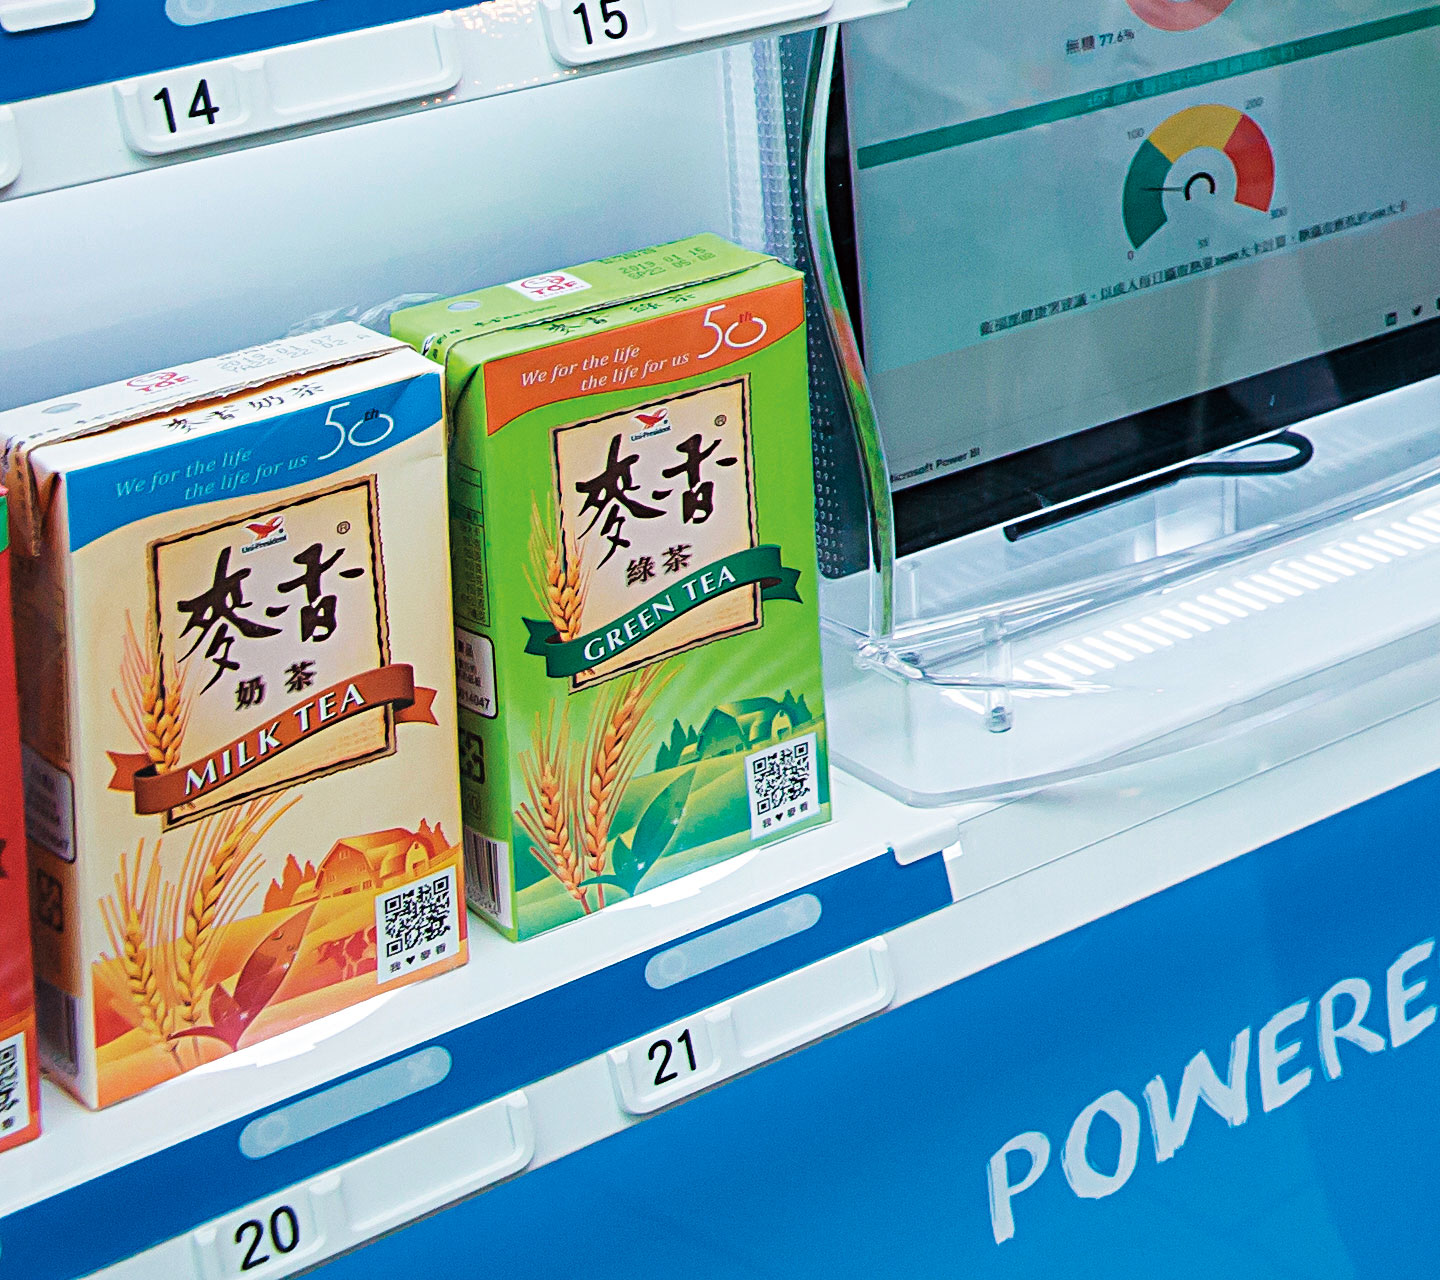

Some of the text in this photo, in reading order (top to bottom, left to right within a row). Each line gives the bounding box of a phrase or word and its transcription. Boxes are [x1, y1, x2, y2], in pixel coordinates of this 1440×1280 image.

[153, 80, 220, 135] 14
[520, 344, 641, 388] We for the life
[580, 351, 690, 392] the life for us
[115, 447, 253, 498] We for the life
[184, 453, 309, 501] the life for us
[576, 433, 738, 570] 麥香
[626, 543, 693, 587] 綠茶
[177, 543, 365, 696] 麥香
[583, 564, 737, 662] GREEN TEA
[235, 661, 317, 712] 奶茶
[184, 682, 366, 797] MILK TEA
[646, 1029, 700, 1088] 21
[233, 1204, 301, 1274] 20
